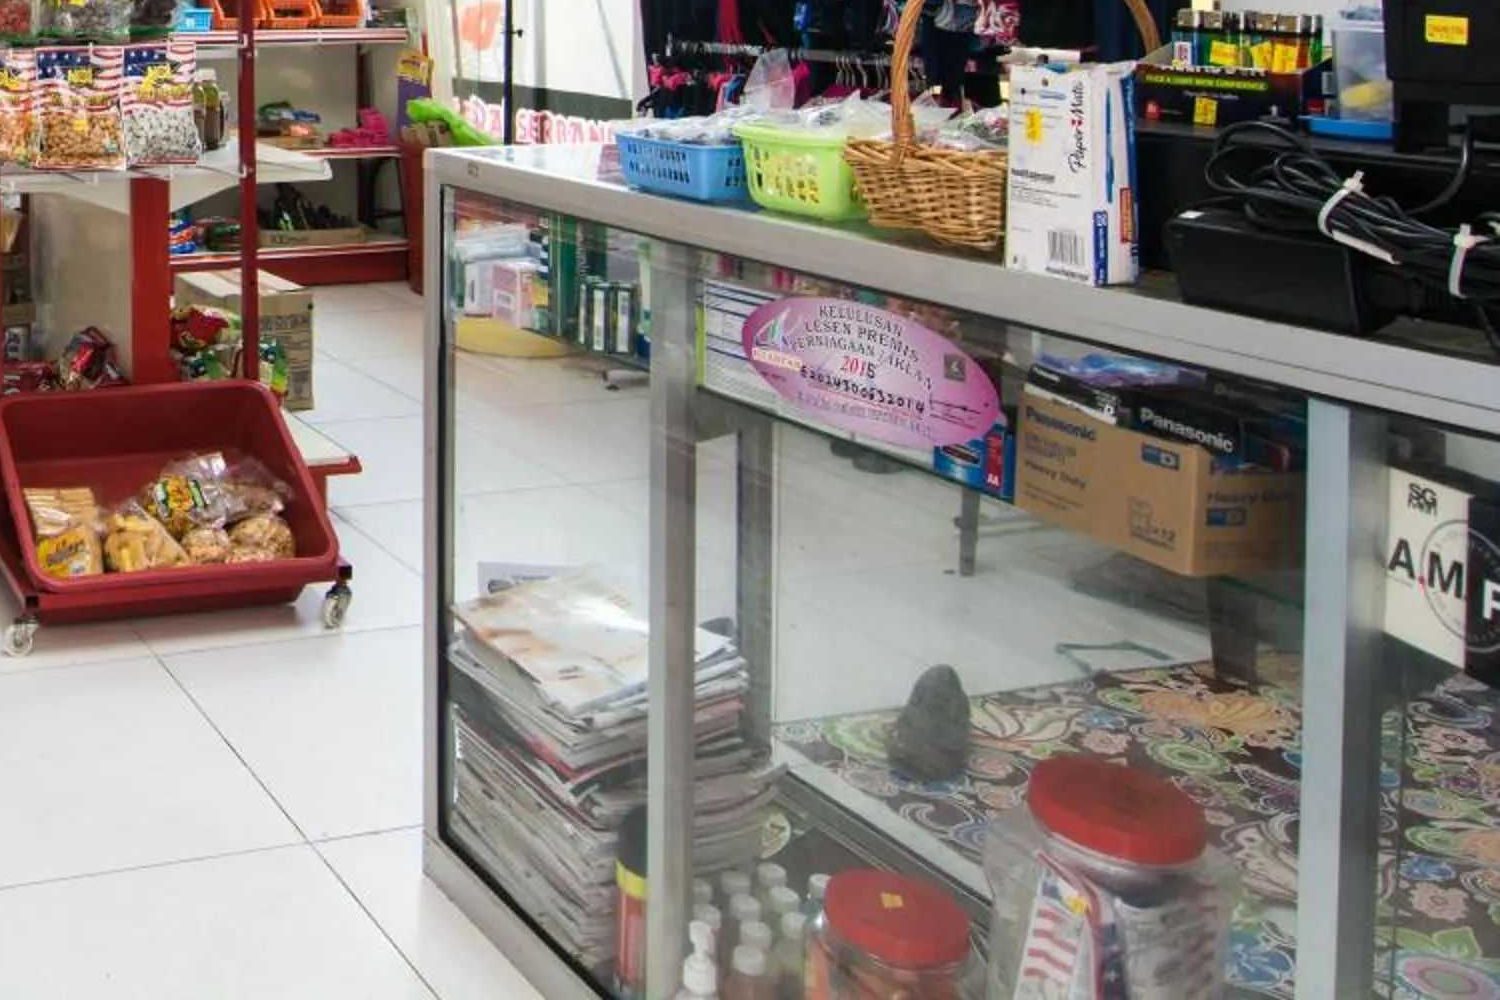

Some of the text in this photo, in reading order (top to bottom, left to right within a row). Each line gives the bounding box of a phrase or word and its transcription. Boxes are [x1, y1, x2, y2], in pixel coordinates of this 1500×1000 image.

[804, 319, 920, 364] LESEN PREMIS
[839, 355, 876, 380] 2015
[1025, 404, 1097, 443] Panasonic
[1139, 407, 1234, 453] Panasonic
